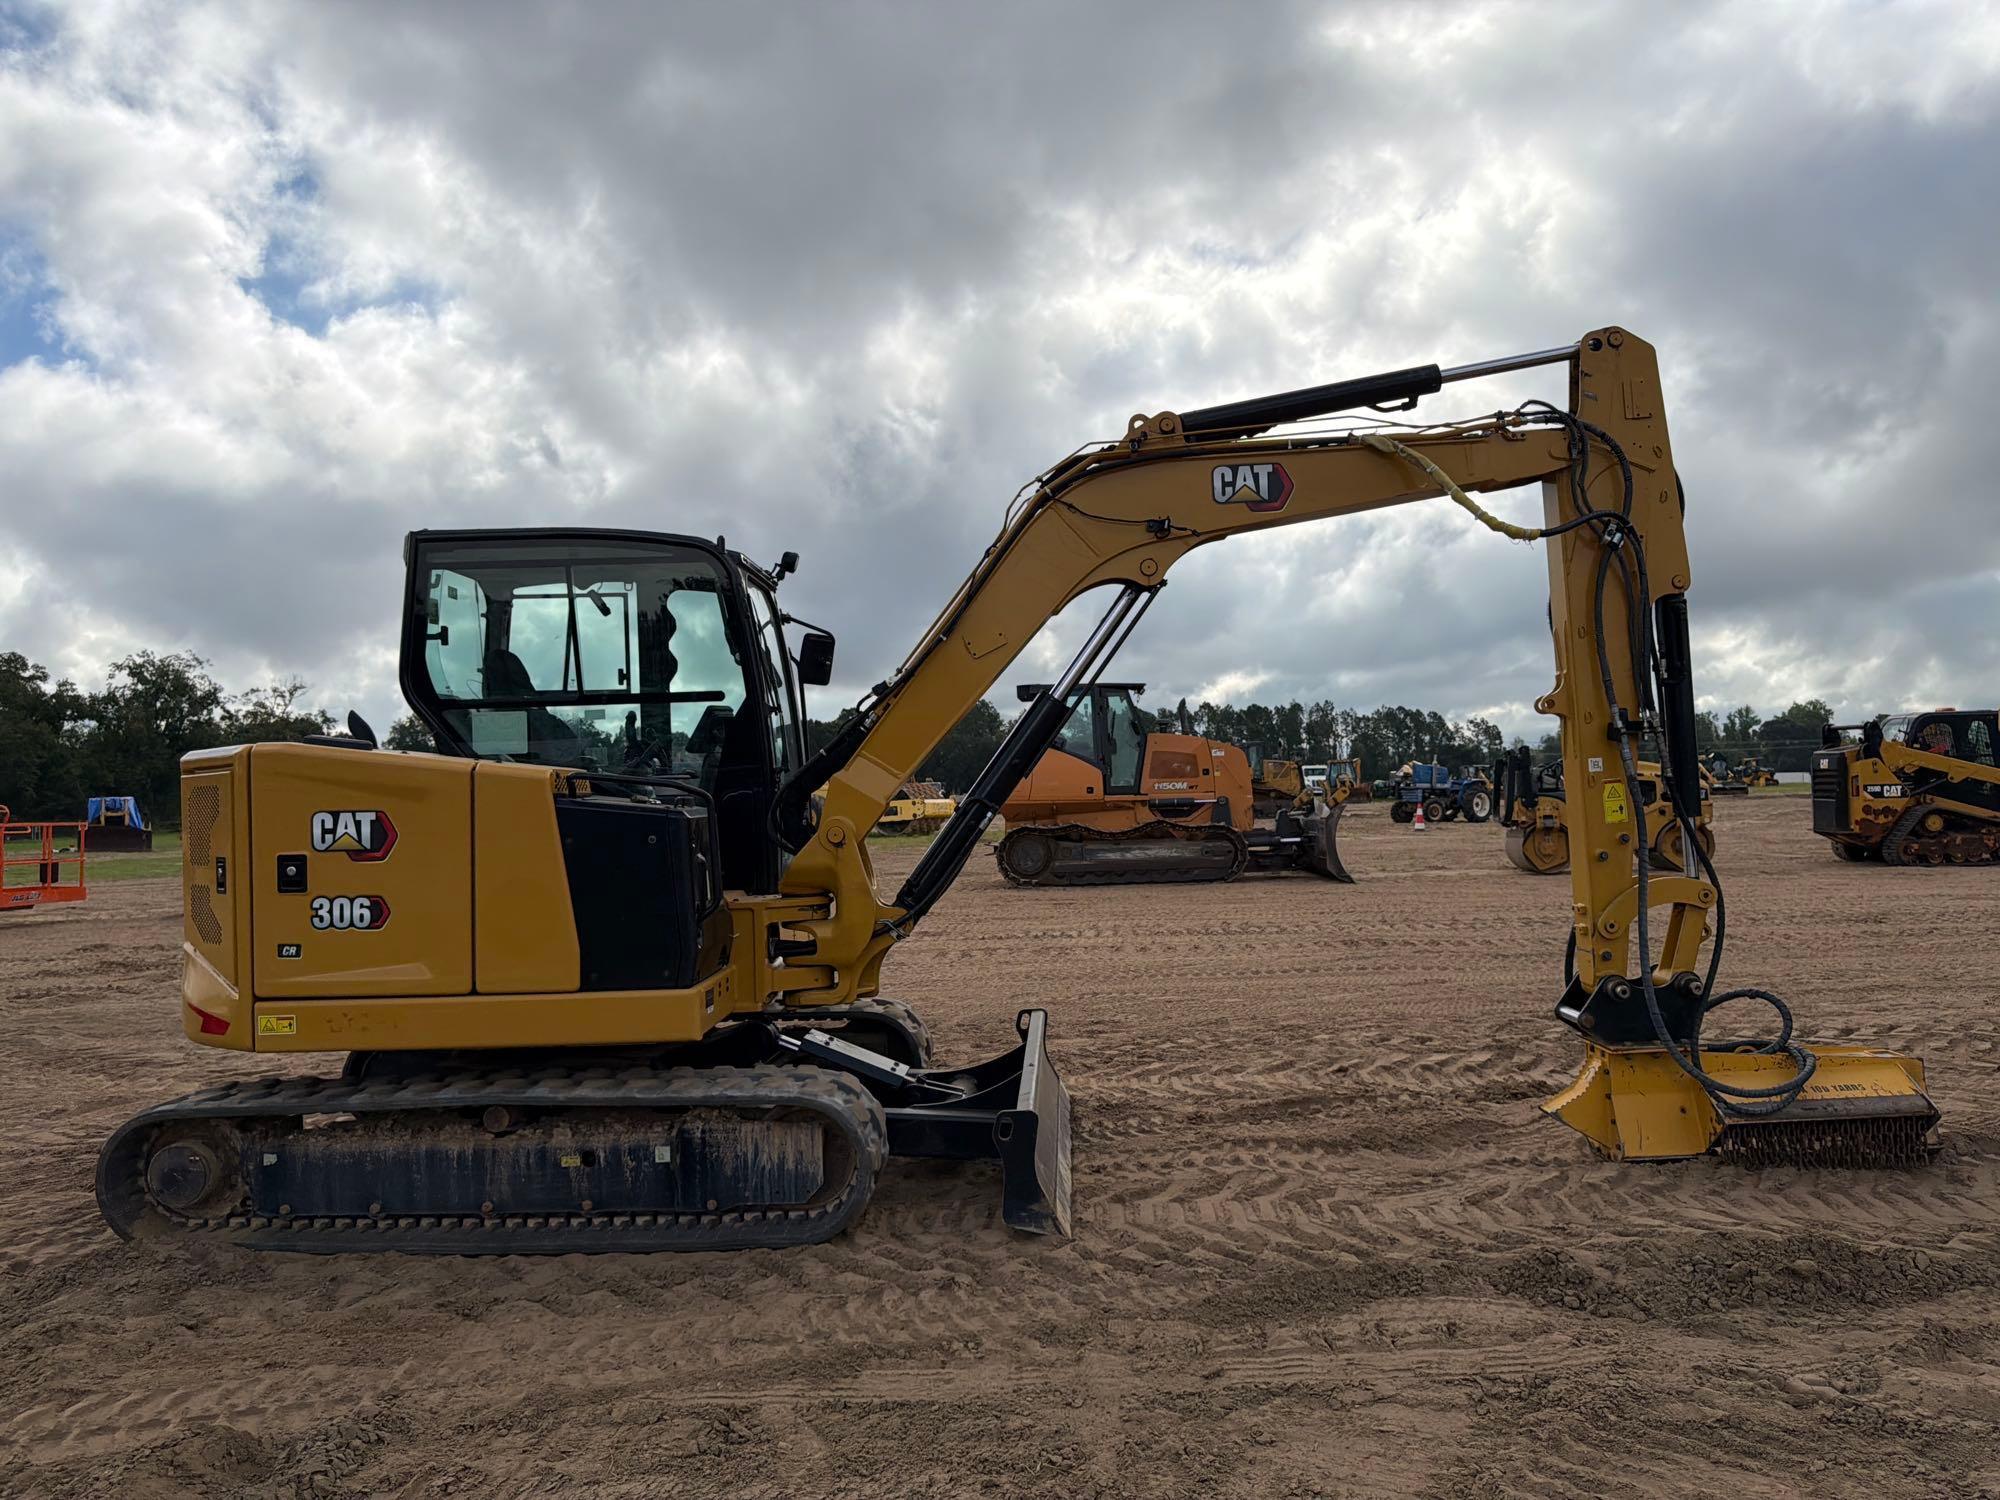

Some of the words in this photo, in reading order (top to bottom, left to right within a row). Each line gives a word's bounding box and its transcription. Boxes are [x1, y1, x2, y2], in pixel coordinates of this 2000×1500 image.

[1213, 464, 1273, 502] CAT
[1883, 785, 1902, 797] CAT
[313, 812, 376, 850] CAT
[312, 897, 371, 928] 306
[282, 946, 297, 956] CR
